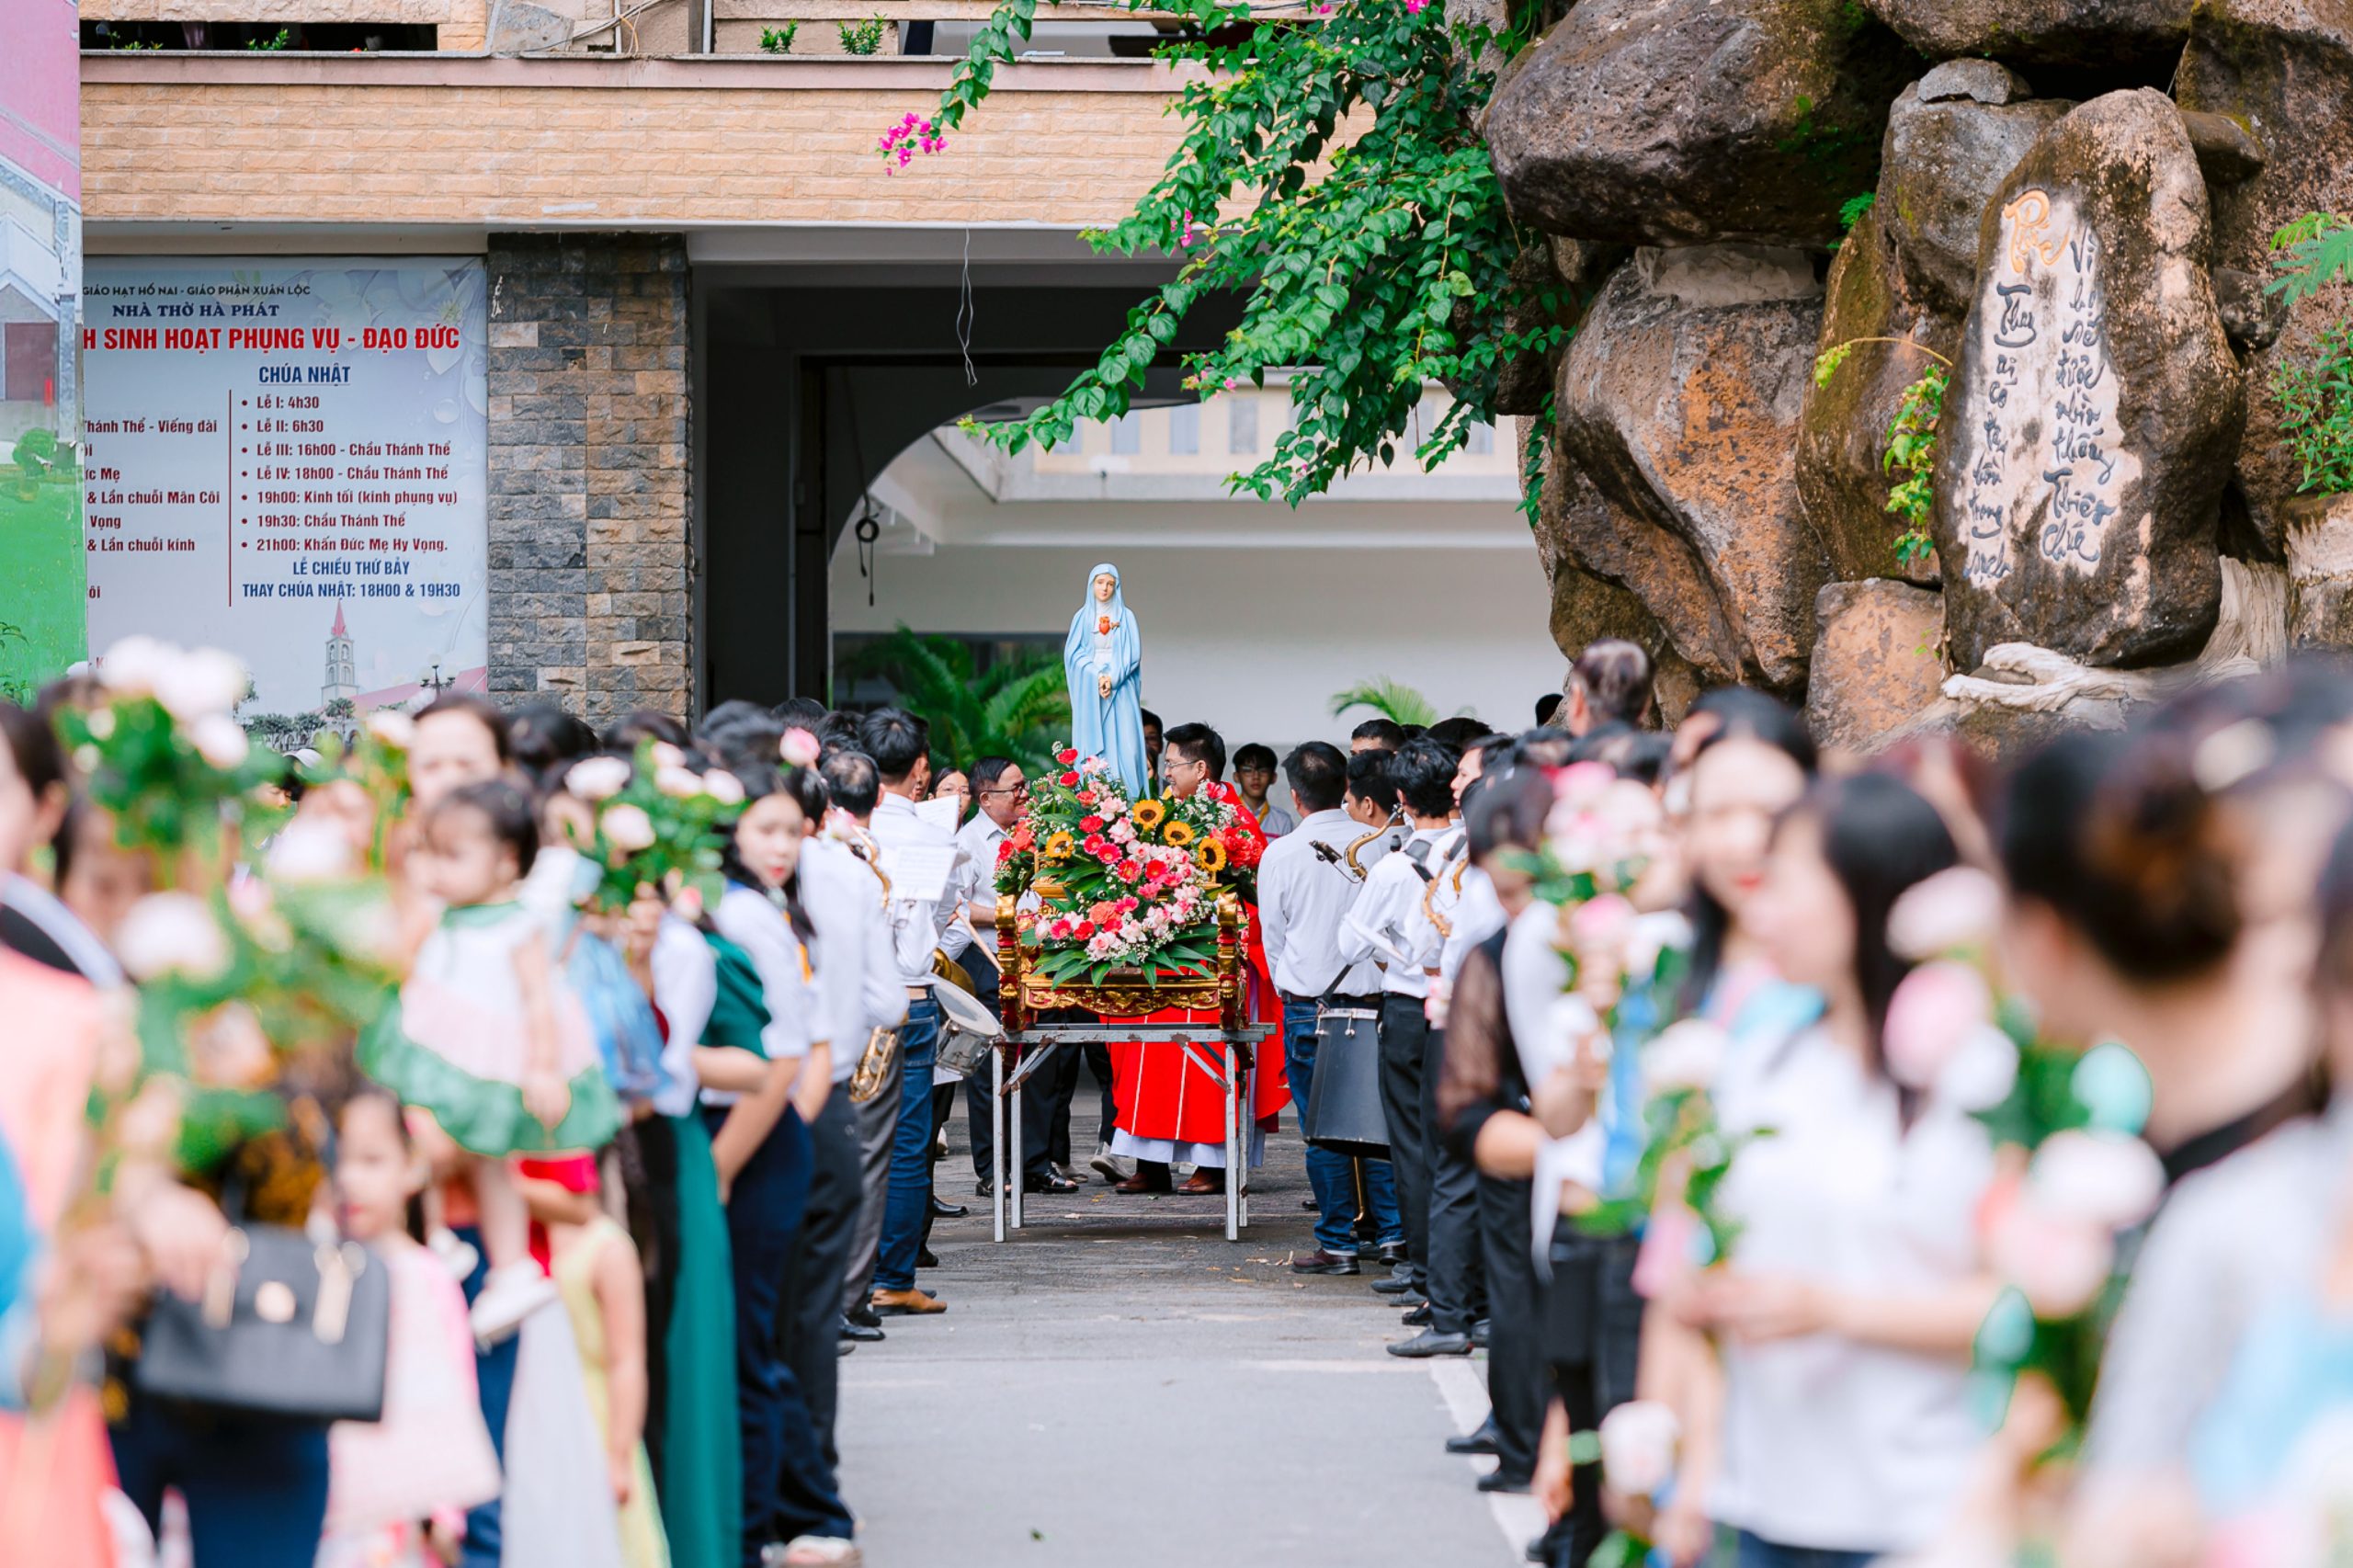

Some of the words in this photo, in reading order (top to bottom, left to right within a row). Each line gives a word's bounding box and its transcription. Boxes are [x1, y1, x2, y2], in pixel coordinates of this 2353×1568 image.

[83, 285, 109, 296] GIÁO
[113, 286, 135, 299] HẠT
[159, 286, 177, 295] NAI
[187, 285, 215, 296] GIÁO
[219, 284, 250, 298] PHẬN
[253, 284, 284, 296] XUÂN
[288, 284, 311, 298] LỘC
[112, 301, 152, 317] NHÀ
[157, 301, 194, 317] THỜ
[199, 301, 225, 317] HÀ
[232, 301, 279, 317] PHÁT
[1995, 282, 2037, 348] Thay
[104, 328, 157, 349] SINH
[165, 328, 222, 354] HOẠT
[229, 328, 304, 354] PHỤNG
[312, 328, 340, 354] VỤ
[363, 328, 408, 354] ĐẠO
[415, 324, 460, 349] ĐỨC
[258, 362, 303, 383] CHÚA
[308, 363, 351, 387] NHẬT
[289, 396, 319, 409] 4h30
[158, 417, 193, 434] Viếng
[276, 420, 289, 432] II:
[292, 420, 324, 432] 6h30
[276, 444, 292, 456] III:
[298, 444, 335, 456] 16h00
[385, 443, 423, 456] Thánh
[428, 440, 450, 456] Thể
[100, 468, 120, 483] Mẹ
[276, 467, 290, 480] IV:
[295, 467, 334, 480] 18h00
[383, 467, 421, 480] Thánh
[426, 464, 449, 480] Thể
[87, 492, 97, 504] &
[168, 492, 195, 504] Mân
[199, 492, 220, 504] Côi
[257, 492, 301, 504] 19h00:
[304, 492, 333, 504] Kinh
[358, 491, 391, 505] (kinh
[395, 492, 434, 506] phụng
[438, 491, 458, 506] vụ)
[90, 516, 121, 529] Vọng
[257, 515, 301, 527] 19h30:
[341, 515, 379, 527] Thánh
[383, 511, 405, 527] Thể
[87, 539, 97, 551] &
[257, 539, 301, 551] 21h00:
[304, 536, 335, 551] Khấn
[340, 537, 365, 551] Đức
[369, 539, 389, 553] Mẹ
[393, 539, 409, 553] Hy
[414, 539, 448, 553] Vọng.
[355, 558, 381, 575] THỨ
[384, 557, 410, 575] BẢY
[243, 584, 274, 597] THAY
[278, 581, 313, 597] CHÚA
[318, 581, 357, 599] NHẬT:
[360, 584, 401, 597] 18H00
[405, 584, 415, 597] &
[419, 584, 460, 597] 19H30
